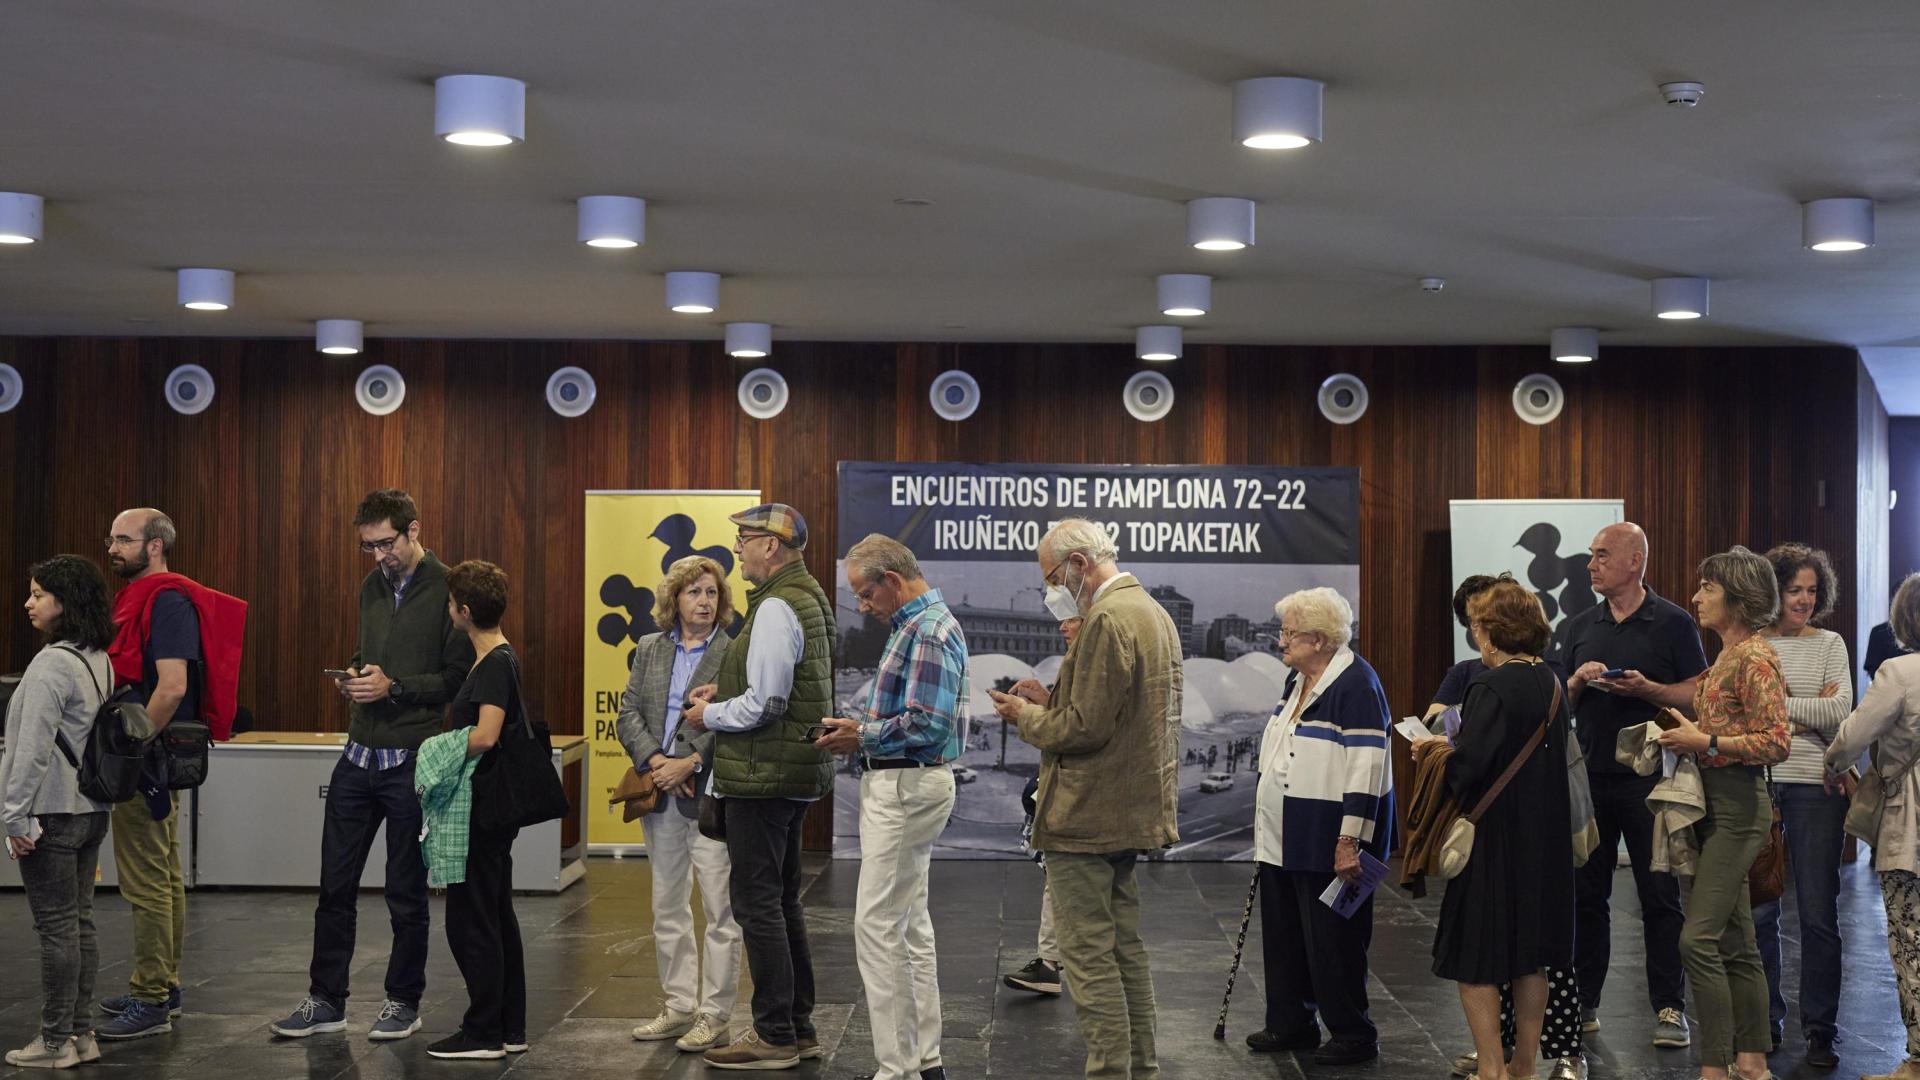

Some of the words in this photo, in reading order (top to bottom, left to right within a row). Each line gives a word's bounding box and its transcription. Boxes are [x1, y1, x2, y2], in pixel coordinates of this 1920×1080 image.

[891, 475, 1049, 508] ENCUENTROS
[1056, 477, 1087, 508] DE
[1094, 478, 1227, 509] PAMPLONA
[1233, 478, 1306, 510] 72-22
[934, 514, 1040, 551] IRUÑEKO
[1126, 521, 1262, 553] TOPAKETAK
